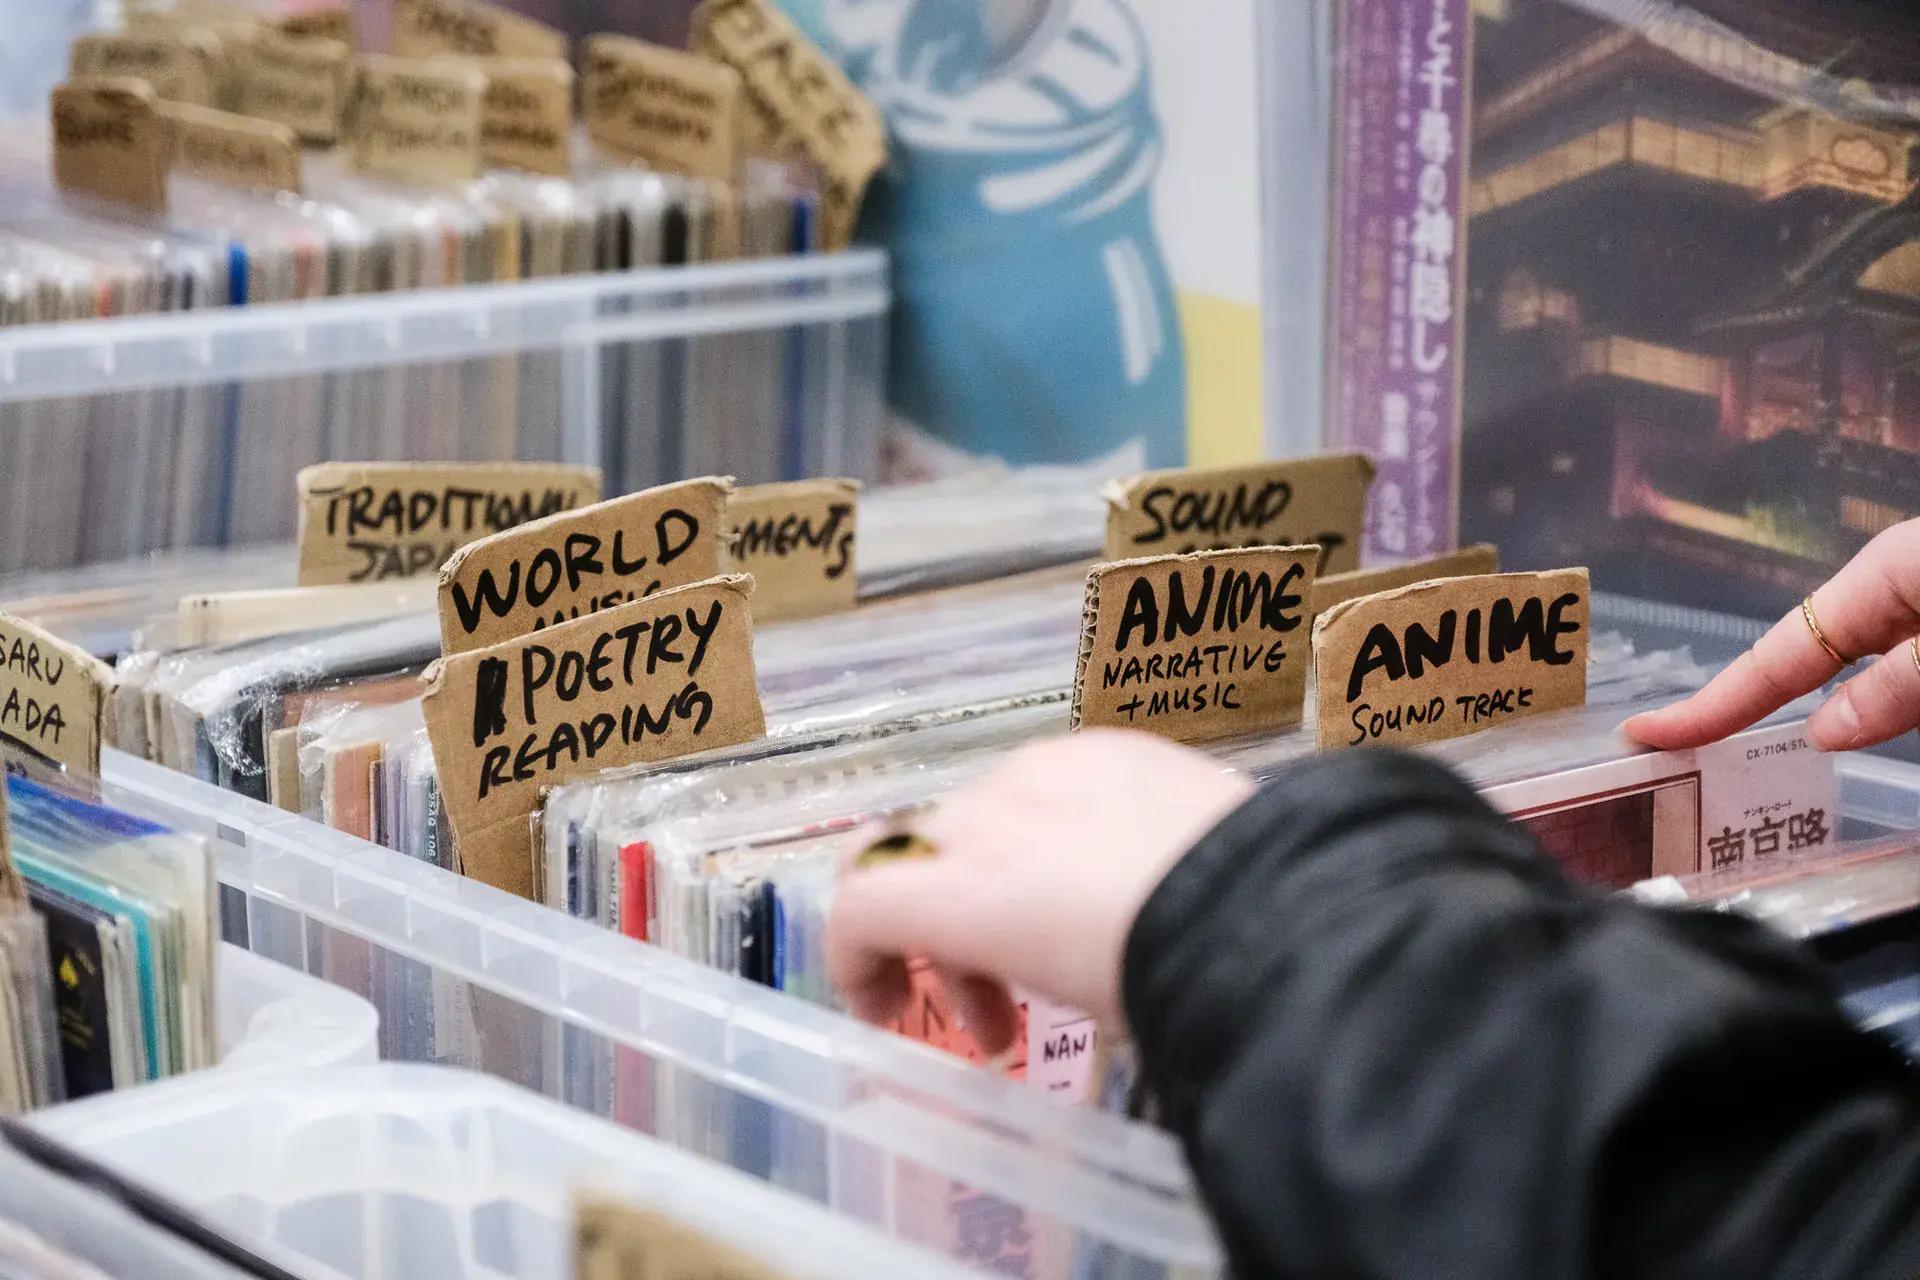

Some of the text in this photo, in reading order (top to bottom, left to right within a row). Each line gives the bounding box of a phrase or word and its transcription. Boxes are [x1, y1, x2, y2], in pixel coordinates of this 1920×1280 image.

[730, 504, 854, 579] MENTS
[1132, 480, 1292, 544] SOUND
[452, 509, 699, 634] WORLD
[1115, 563, 1305, 653] ANIME
[522, 600, 722, 725] POETRY
[1102, 640, 1286, 690] NARRATIVE
[1346, 592, 1581, 702] ANIME
[477, 681, 713, 802] READING
[1348, 685, 1533, 746] SOUND TRACK
